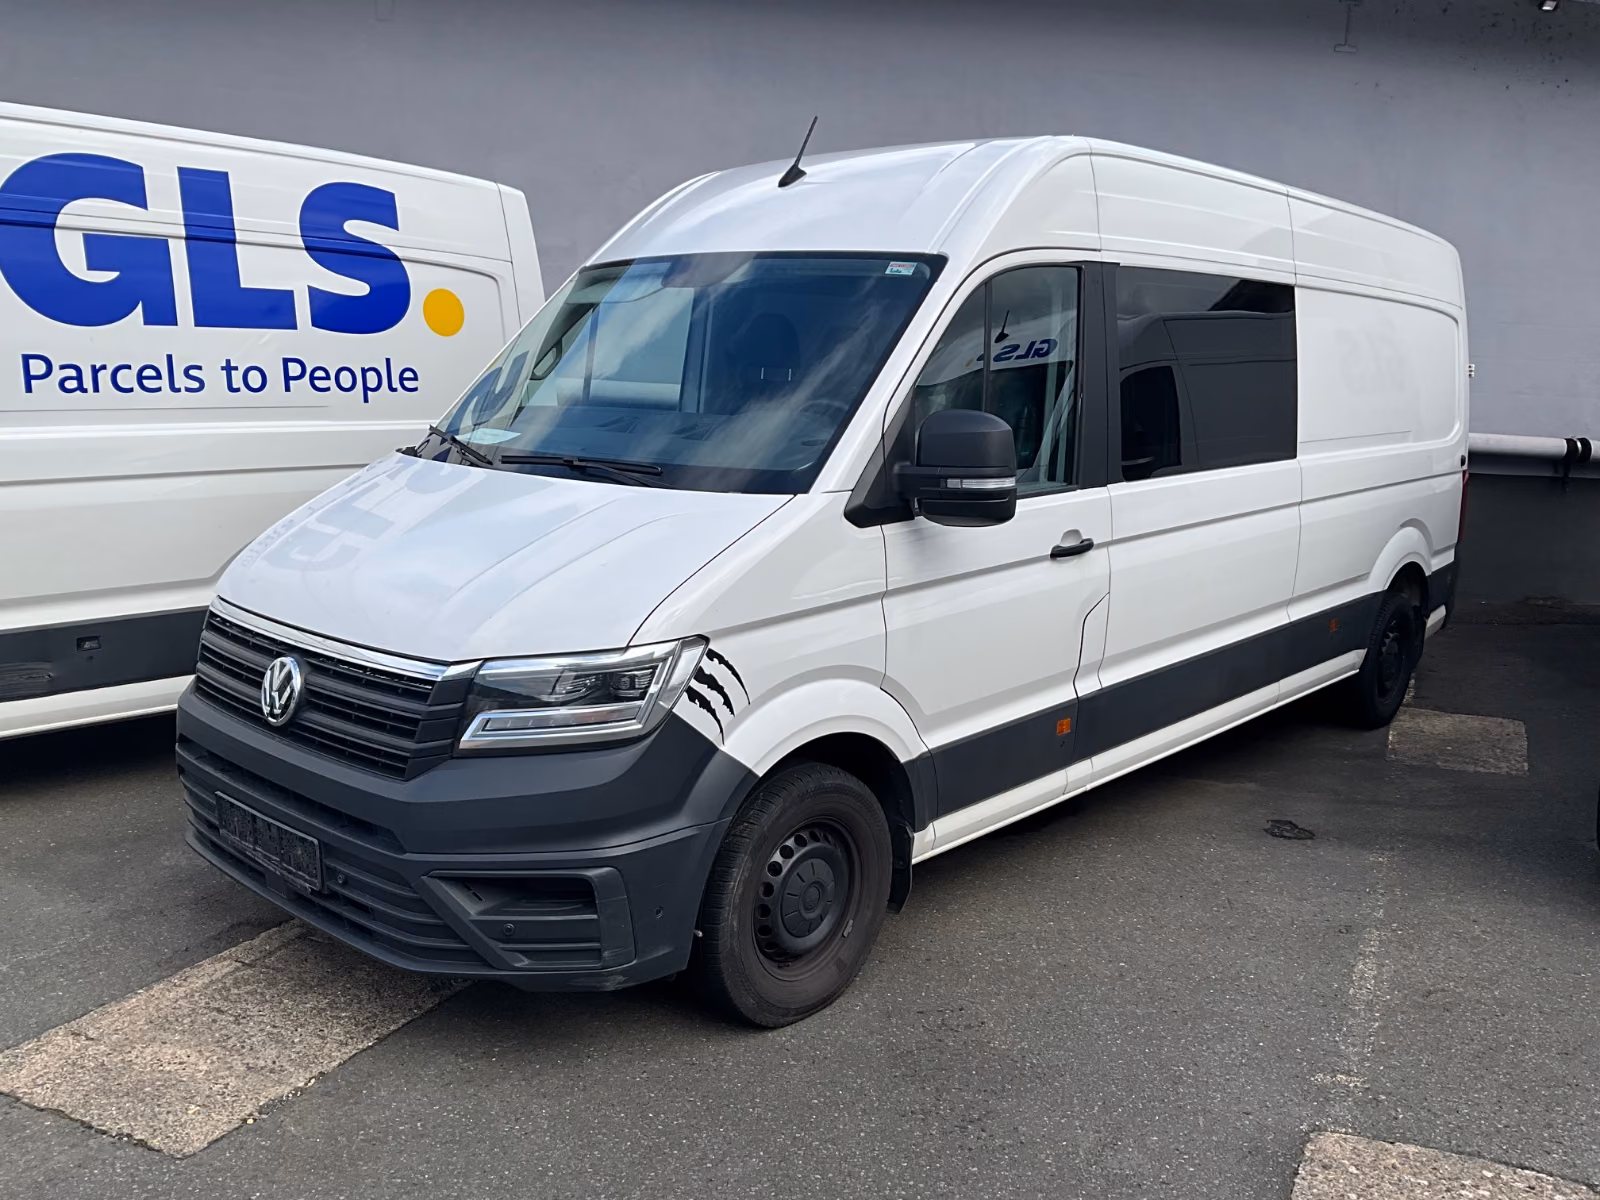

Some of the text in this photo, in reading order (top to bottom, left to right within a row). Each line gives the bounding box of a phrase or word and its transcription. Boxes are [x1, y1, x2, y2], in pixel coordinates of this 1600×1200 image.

[21, 353, 205, 394] Parcels
[224, 358, 268, 394] to
[282, 356, 420, 404] People
